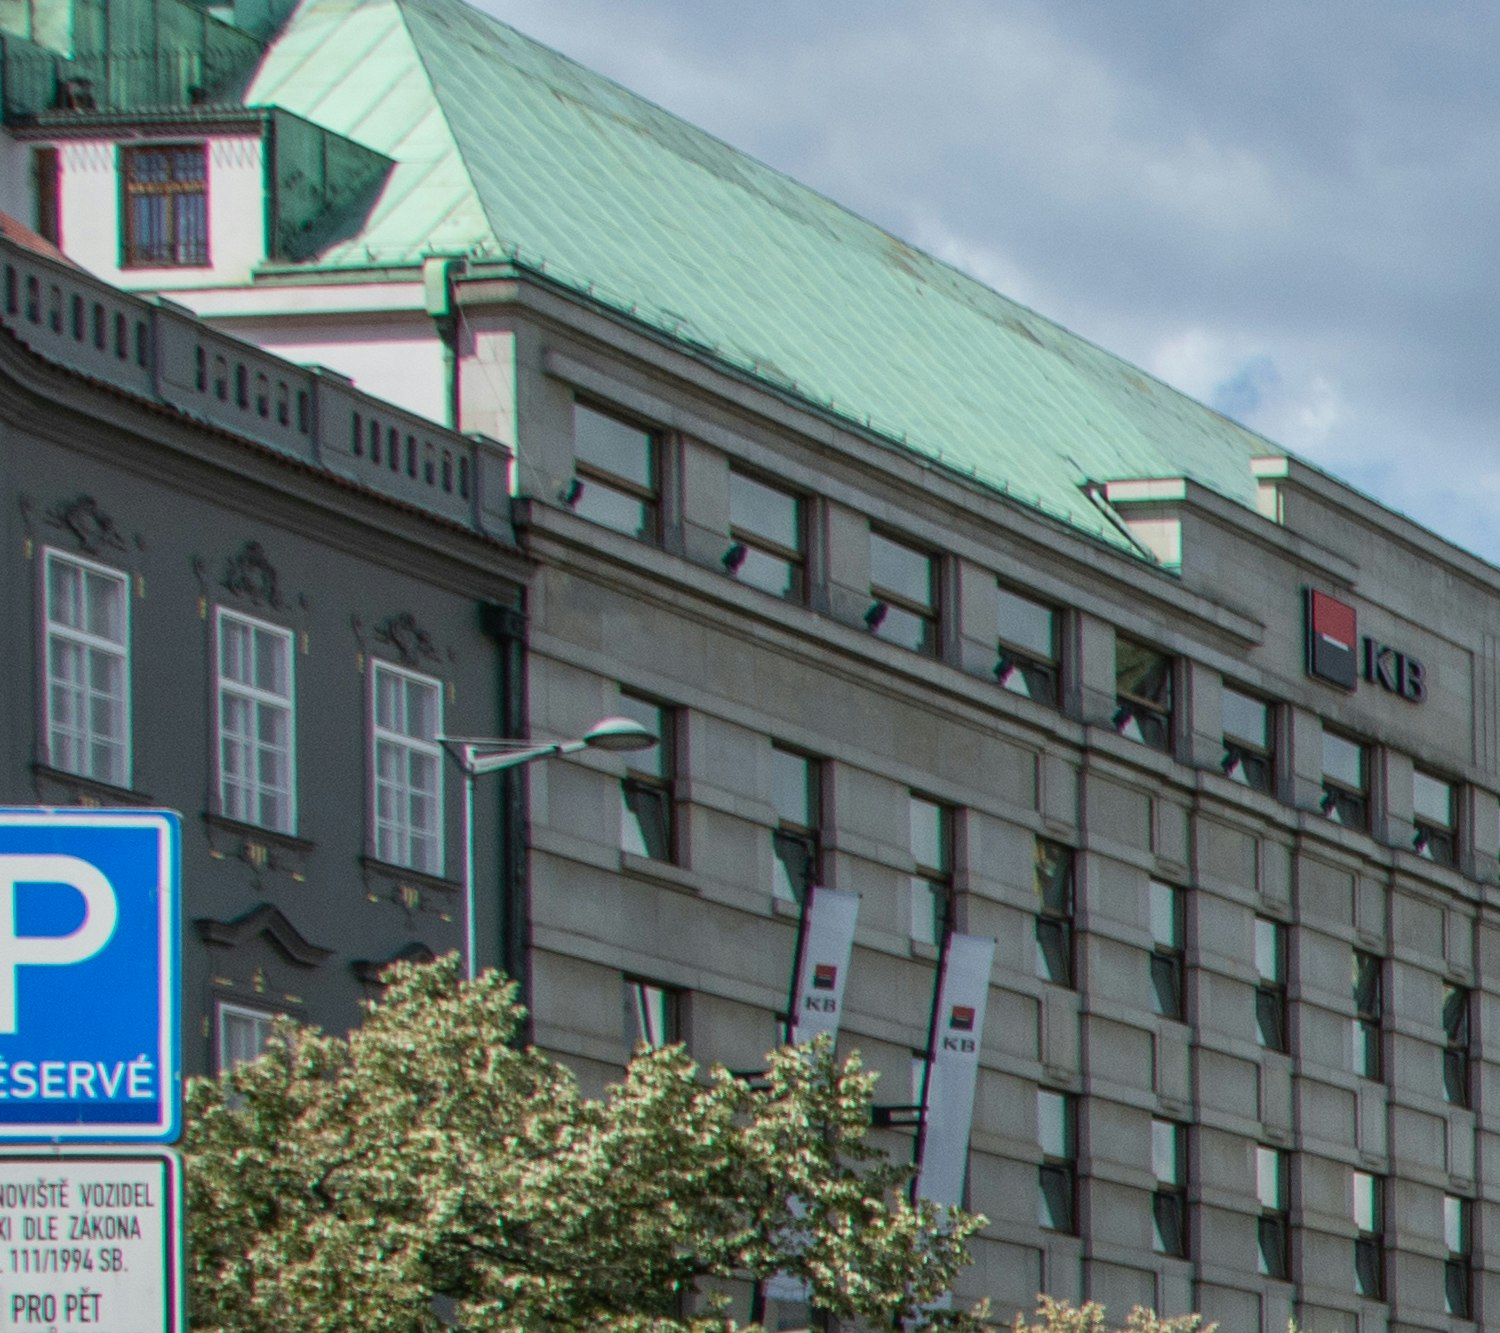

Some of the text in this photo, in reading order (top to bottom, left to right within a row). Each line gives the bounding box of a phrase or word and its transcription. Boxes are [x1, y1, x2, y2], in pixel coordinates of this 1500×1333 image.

[1364, 636, 1427, 701] KB
[0, 853, 119, 1034] P
[805, 996, 837, 1014] KB
[943, 1036, 976, 1054] KB
[81, 1183, 155, 1208] VOZIDEL
[24, 1216, 59, 1240] DLE
[69, 1210, 142, 1240] ZÁKONA
[10, 1248, 129, 1273] 111/1994 SB.
[12, 1286, 103, 1323] PRO PĚT
